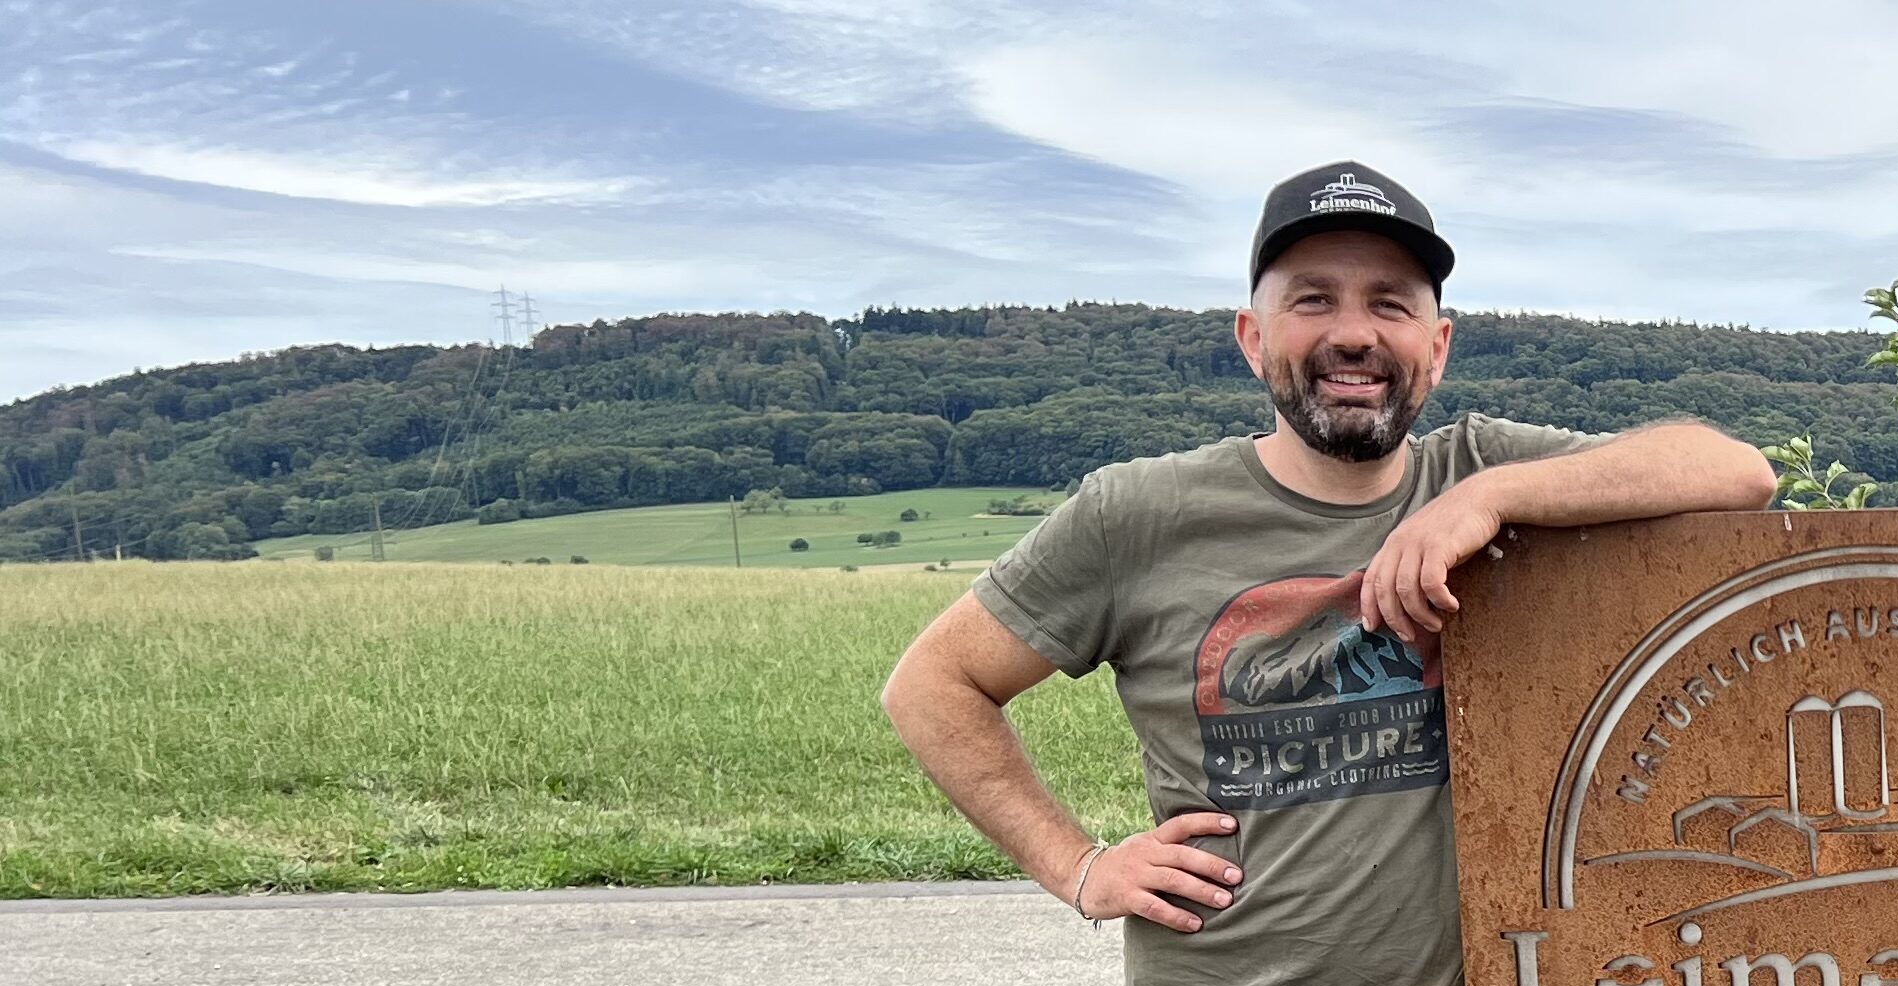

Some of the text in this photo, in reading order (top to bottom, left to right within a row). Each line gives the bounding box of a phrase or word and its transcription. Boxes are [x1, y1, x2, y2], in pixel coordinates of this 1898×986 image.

[1309, 195, 1396, 216] Leimenhof
[1273, 708, 1380, 736] ESTD 2008
[1615, 618, 1806, 805] NATÜRLICH
[1231, 721, 1425, 775] PICTURE
[1254, 763, 1401, 798] ORGANIC CLOTHING
